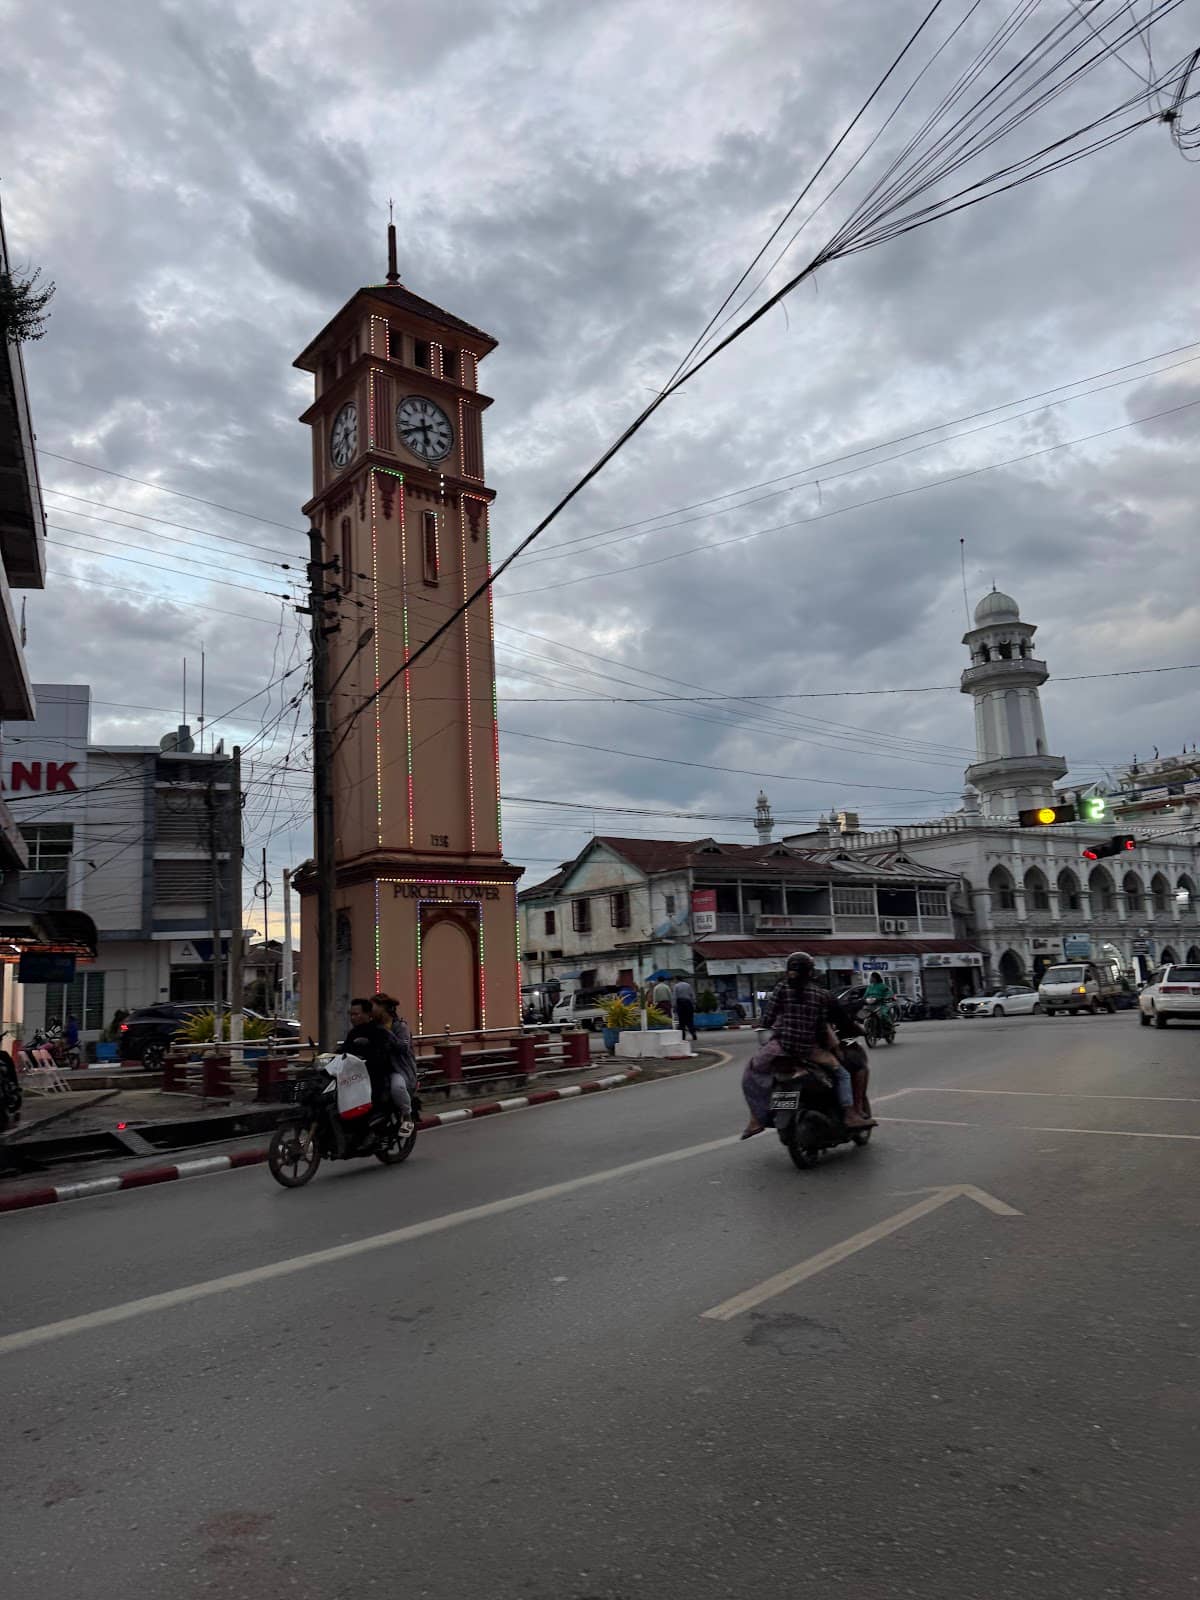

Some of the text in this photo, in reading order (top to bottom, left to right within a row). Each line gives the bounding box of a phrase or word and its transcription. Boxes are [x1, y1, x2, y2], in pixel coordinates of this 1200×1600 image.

[0, 761, 78, 792] NK
[1091, 798, 1105, 819] 2
[393, 884, 500, 901] PURCELL TOWER
